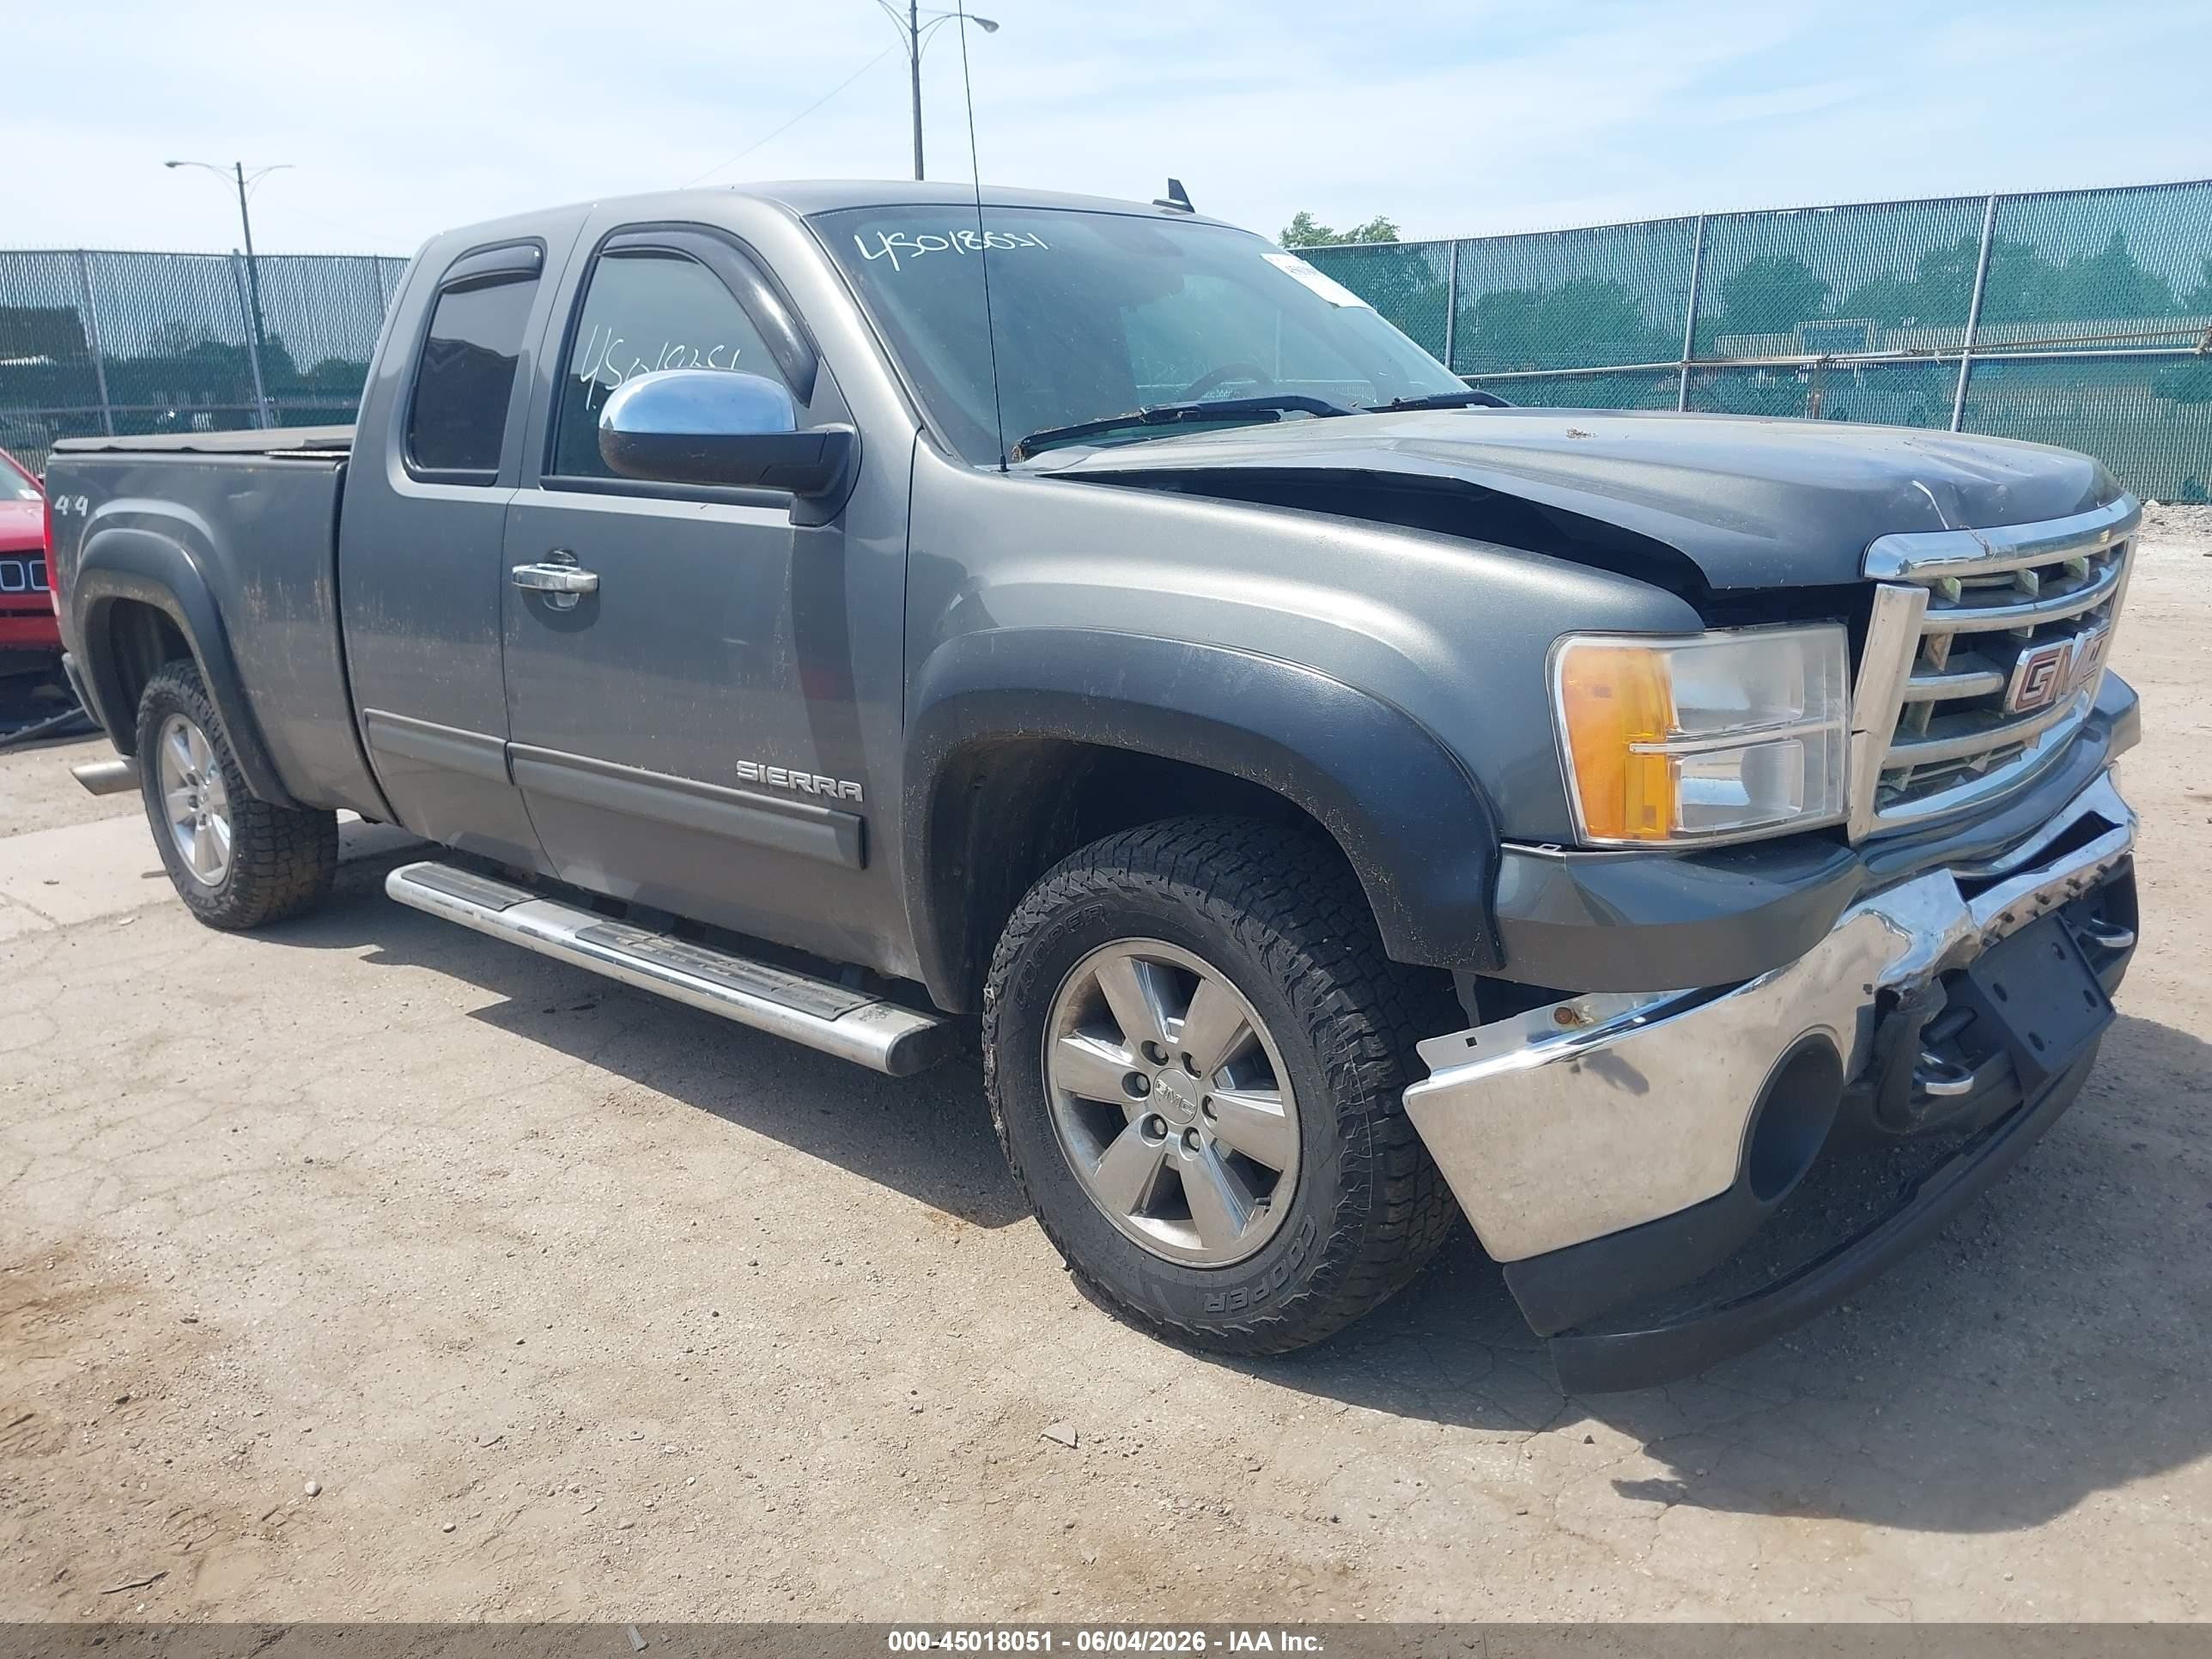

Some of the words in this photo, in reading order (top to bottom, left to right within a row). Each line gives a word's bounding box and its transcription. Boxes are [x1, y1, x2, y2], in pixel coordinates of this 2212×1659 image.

[2014, 627, 2110, 714] GMC
[736, 759, 864, 803] SIERRA
[1015, 903, 1104, 1010] COOPER
[1155, 1079, 1196, 1116] GMC
[1204, 1213, 1317, 1313] COOPER
